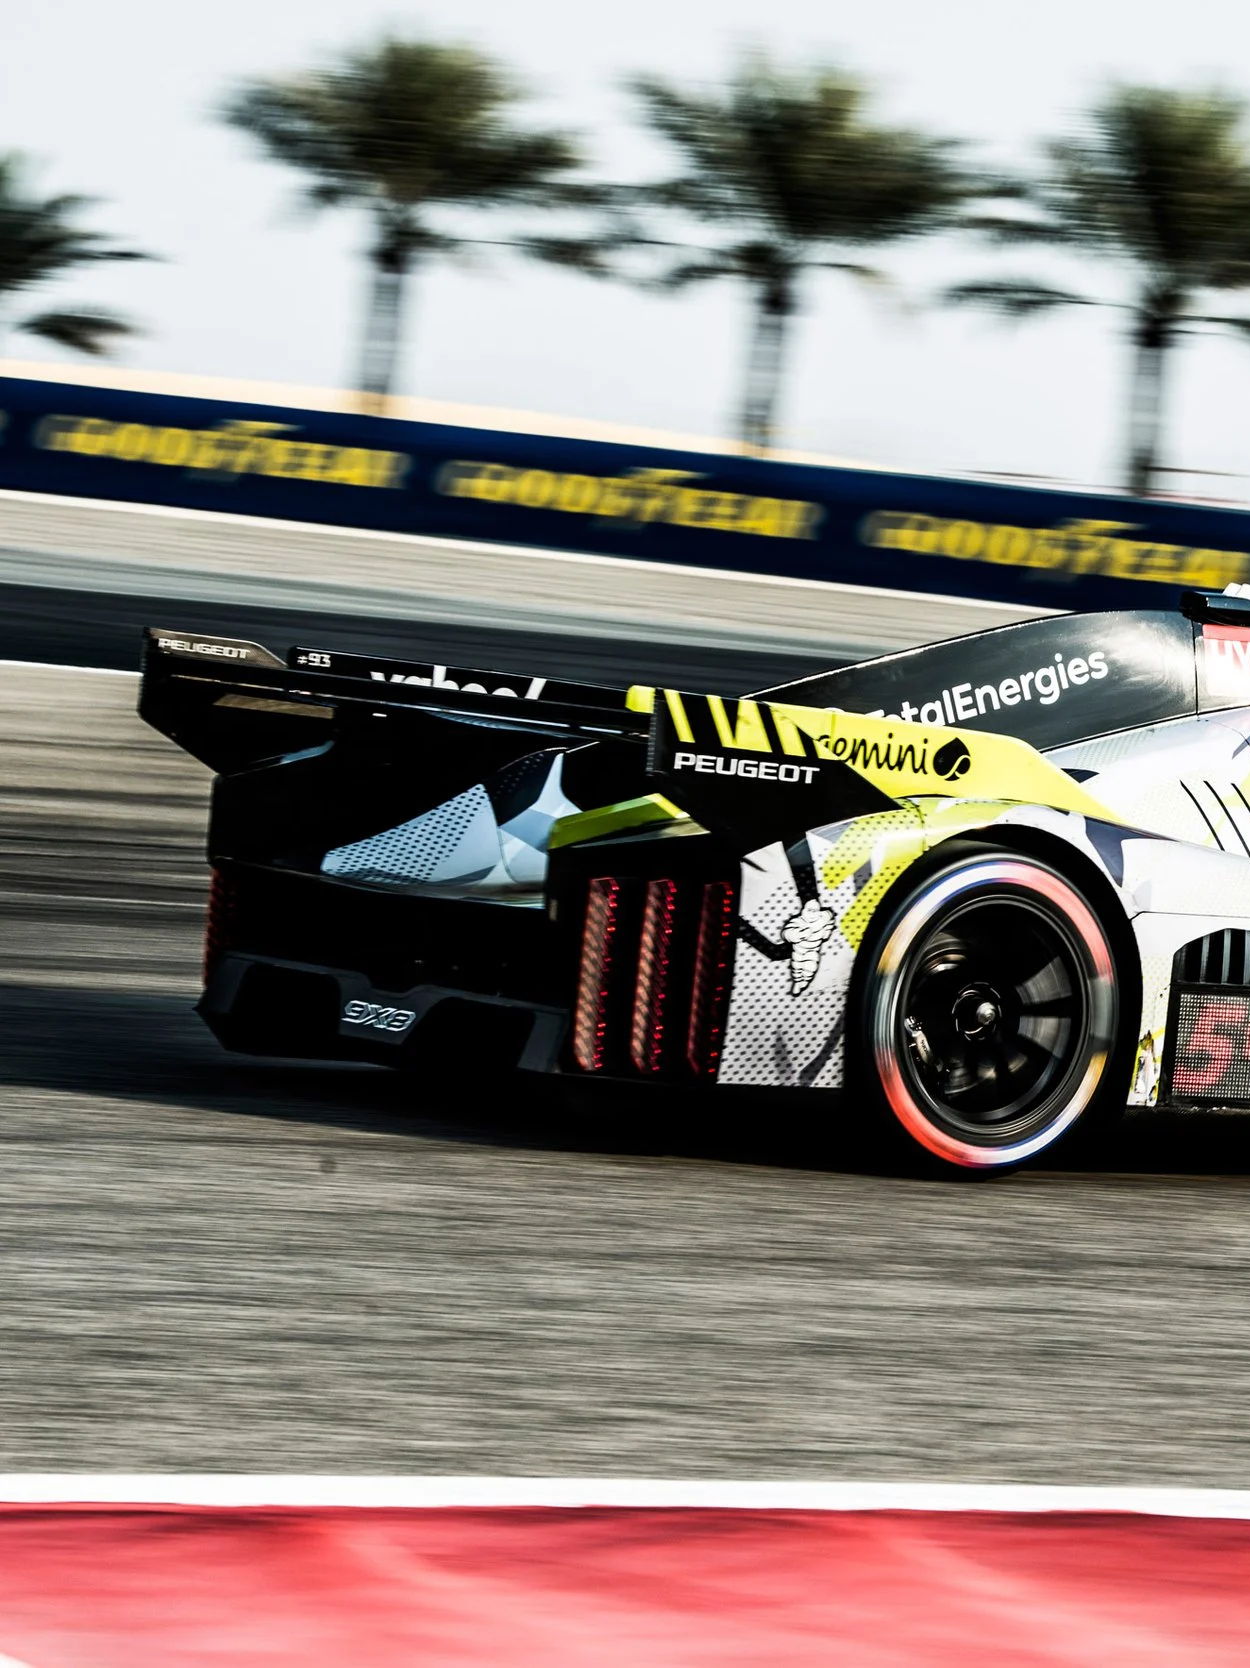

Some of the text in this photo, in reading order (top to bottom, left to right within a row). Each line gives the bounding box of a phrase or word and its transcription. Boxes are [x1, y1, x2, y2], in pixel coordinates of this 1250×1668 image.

[158, 638, 250, 659] PEUGEOT
[297, 652, 331, 668] #93
[865, 652, 1108, 727] talEnergies
[673, 752, 820, 784] PEUGEOT
[341, 999, 417, 1032] 9X8
